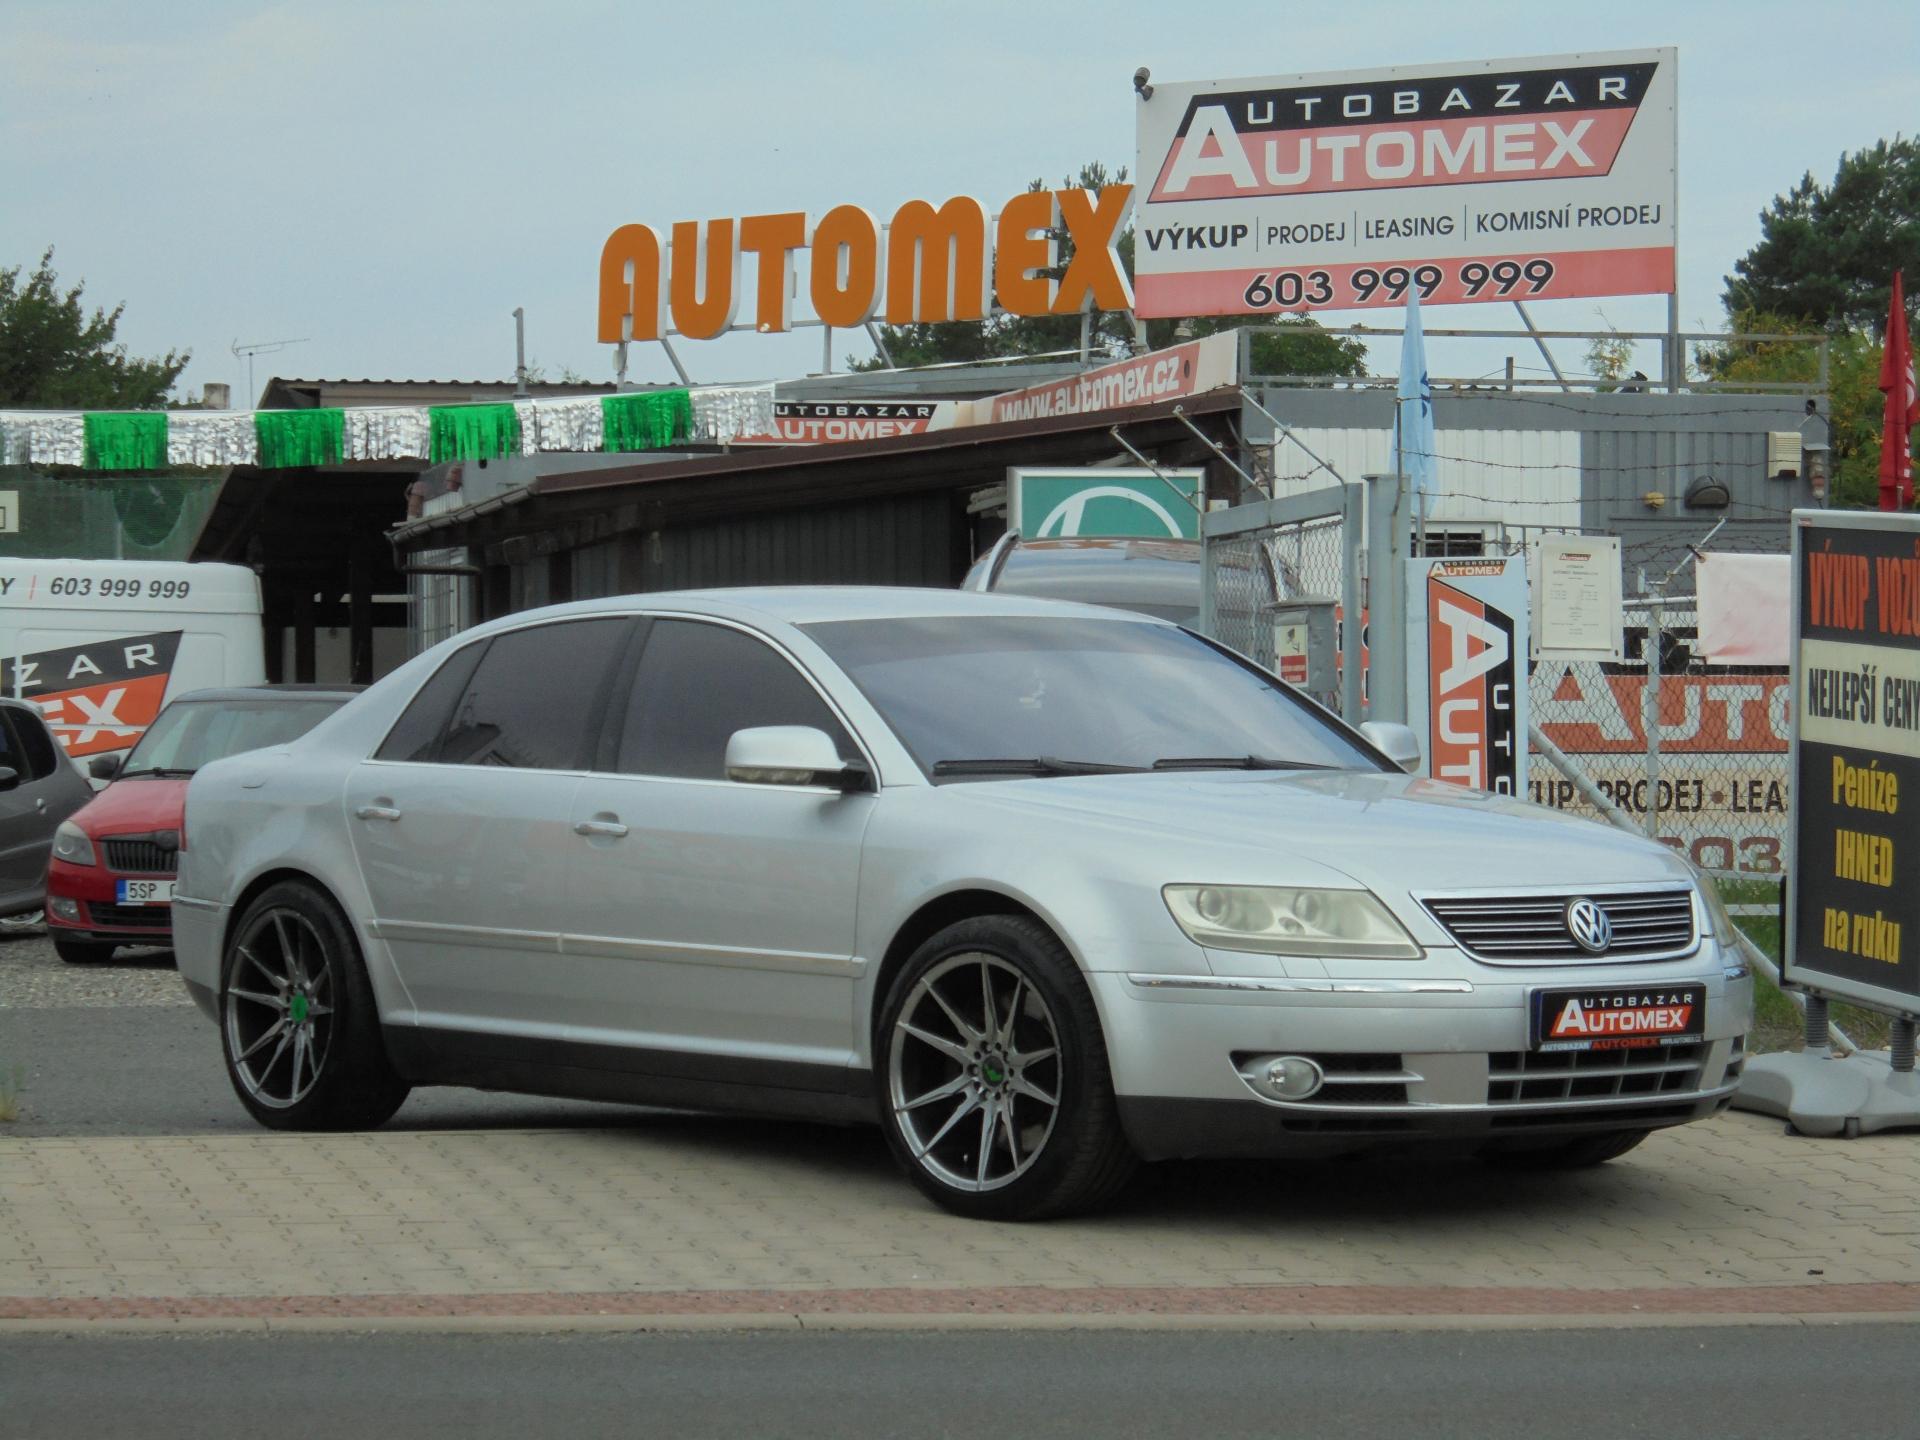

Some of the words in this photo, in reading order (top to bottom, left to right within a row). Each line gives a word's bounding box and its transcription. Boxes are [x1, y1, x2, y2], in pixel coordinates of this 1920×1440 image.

[1162, 105, 1596, 193] AUTOMEX
[1145, 217, 1249, 252] VÝKUP
[1267, 221, 1346, 246] PRODEJ
[1364, 215, 1455, 240] LEASING
[1476, 203, 1573, 234] KOMISNÍ
[1577, 204, 1662, 229] PRODEJ
[597, 183, 1134, 343] AUTOMEX
[1243, 270, 1333, 309] 603
[1350, 264, 1444, 304] 999
[1459, 258, 1555, 299] 999
[1001, 356, 1180, 423] www.automex.cz
[50, 577, 92, 596] 603
[99, 579, 141, 598] 999
[148, 580, 190, 599] 999
[1431, 562, 1502, 577] AUTOMEX
[1808, 538, 1870, 632] VÝKUP
[1808, 664, 1877, 725] NEJLEPŠÍ
[1732, 780, 1788, 813] LEA
[1832, 756, 1898, 815] Peníze
[1835, 828, 1893, 888] IHNED
[129, 882, 157, 898] 5SP
[1823, 907, 1849, 953] na
[1852, 910, 1900, 965] ruku
[1556, 999, 1684, 1034] AUTOMEX
